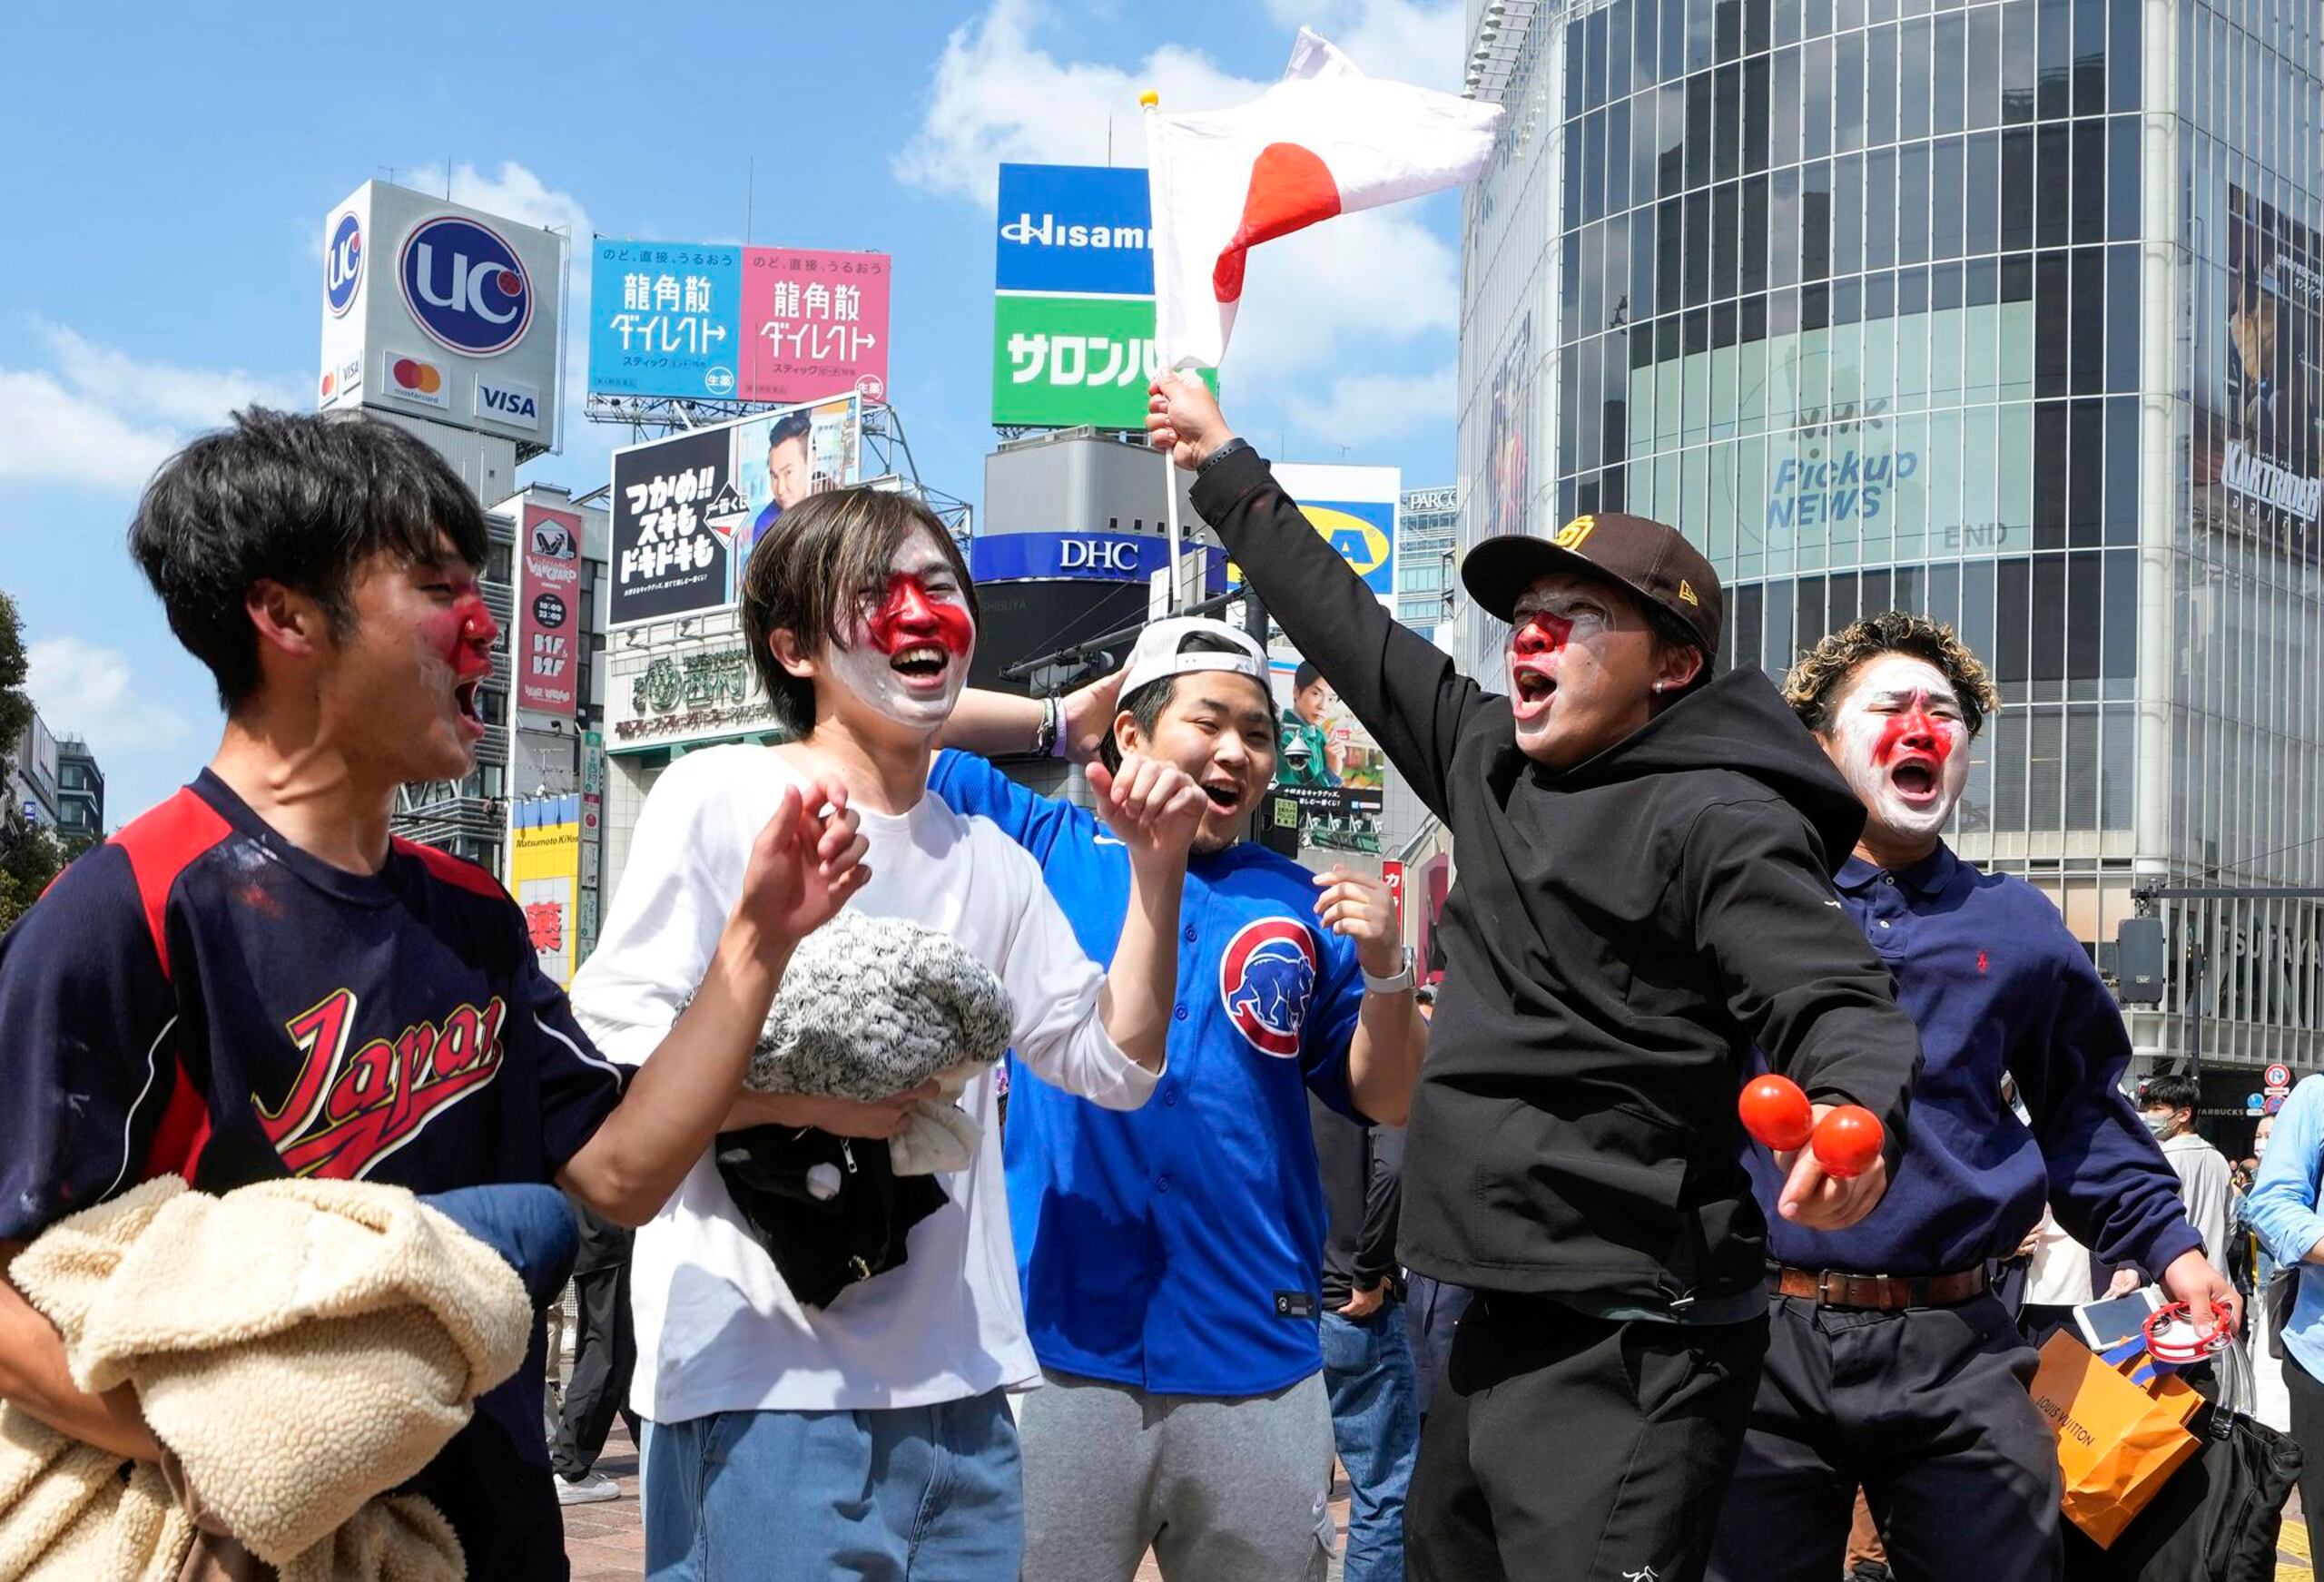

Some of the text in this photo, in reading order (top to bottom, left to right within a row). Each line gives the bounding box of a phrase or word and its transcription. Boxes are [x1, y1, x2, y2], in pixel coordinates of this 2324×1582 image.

[330, 231, 359, 290] UC
[417, 241, 523, 324] UC
[624, 272, 712, 314] 龍角散
[773, 280, 862, 322] 龍角散
[609, 313, 727, 355] ダイレクト
[760, 321, 877, 362] ダイレクト
[343, 359, 359, 381] VISA
[623, 356, 669, 368] スティック
[773, 364, 818, 375] スティック
[393, 388, 439, 405] mastercard
[479, 385, 536, 418] VISA
[1788, 397, 1888, 442] NHK
[1773, 447, 1918, 496] Pickup
[635, 504, 697, 546] スキも
[1767, 486, 1882, 531] NEWS
[1059, 539, 1139, 571] DHC
[1944, 522, 2009, 549] END
[620, 534, 714, 585] ドキドキも
[534, 634, 565, 653] B1F
[533, 654, 565, 676] B2F
[516, 835, 557, 849] Matsumoto
[526, 901, 563, 954] 薬
[2220, 925, 2322, 969] TSUTAYA
[2036, 1395, 2095, 1447] LOUIS VUITTON
